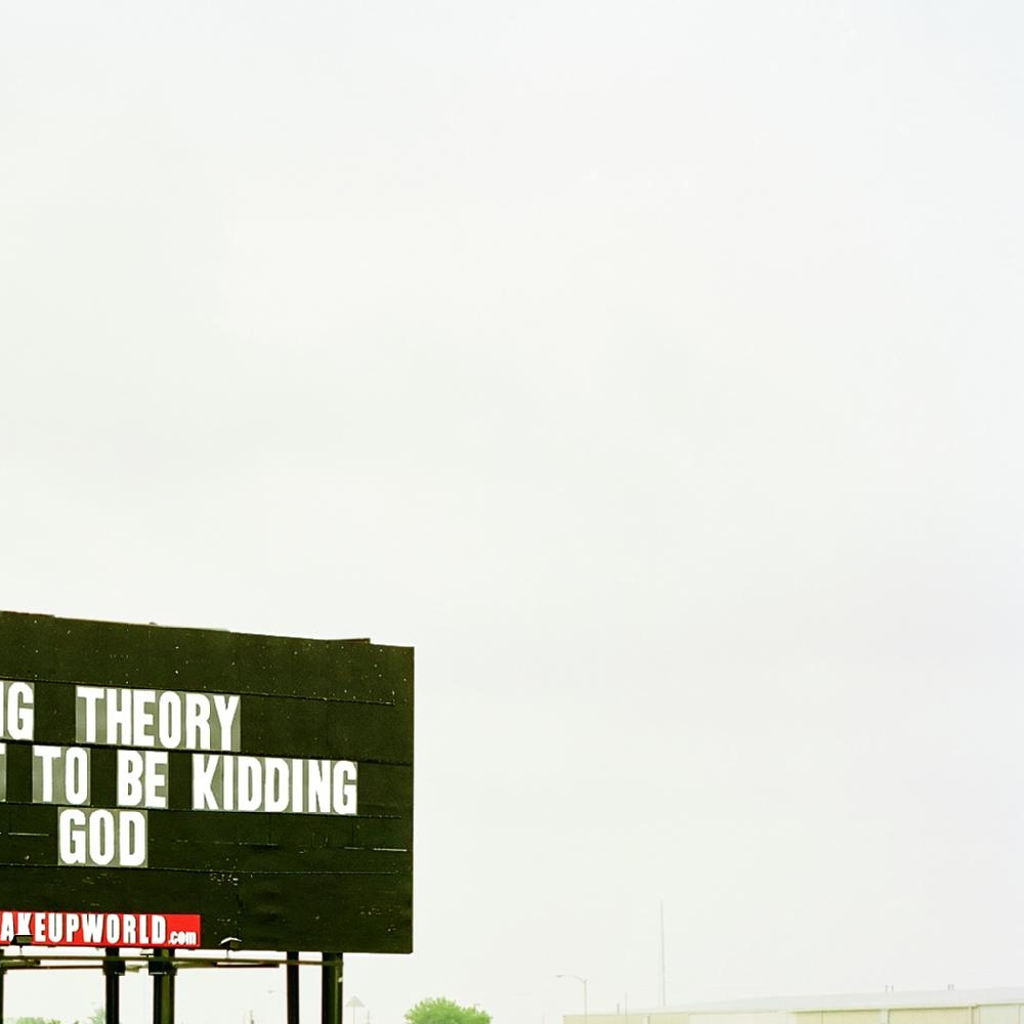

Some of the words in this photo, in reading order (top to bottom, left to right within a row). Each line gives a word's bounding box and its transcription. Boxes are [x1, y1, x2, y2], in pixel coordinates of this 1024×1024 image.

[76, 686, 240, 751] THEORY
[32, 745, 88, 805] TO
[118, 750, 168, 808] BE
[192, 753, 357, 815] KIDDING
[59, 809, 145, 866] GOD
